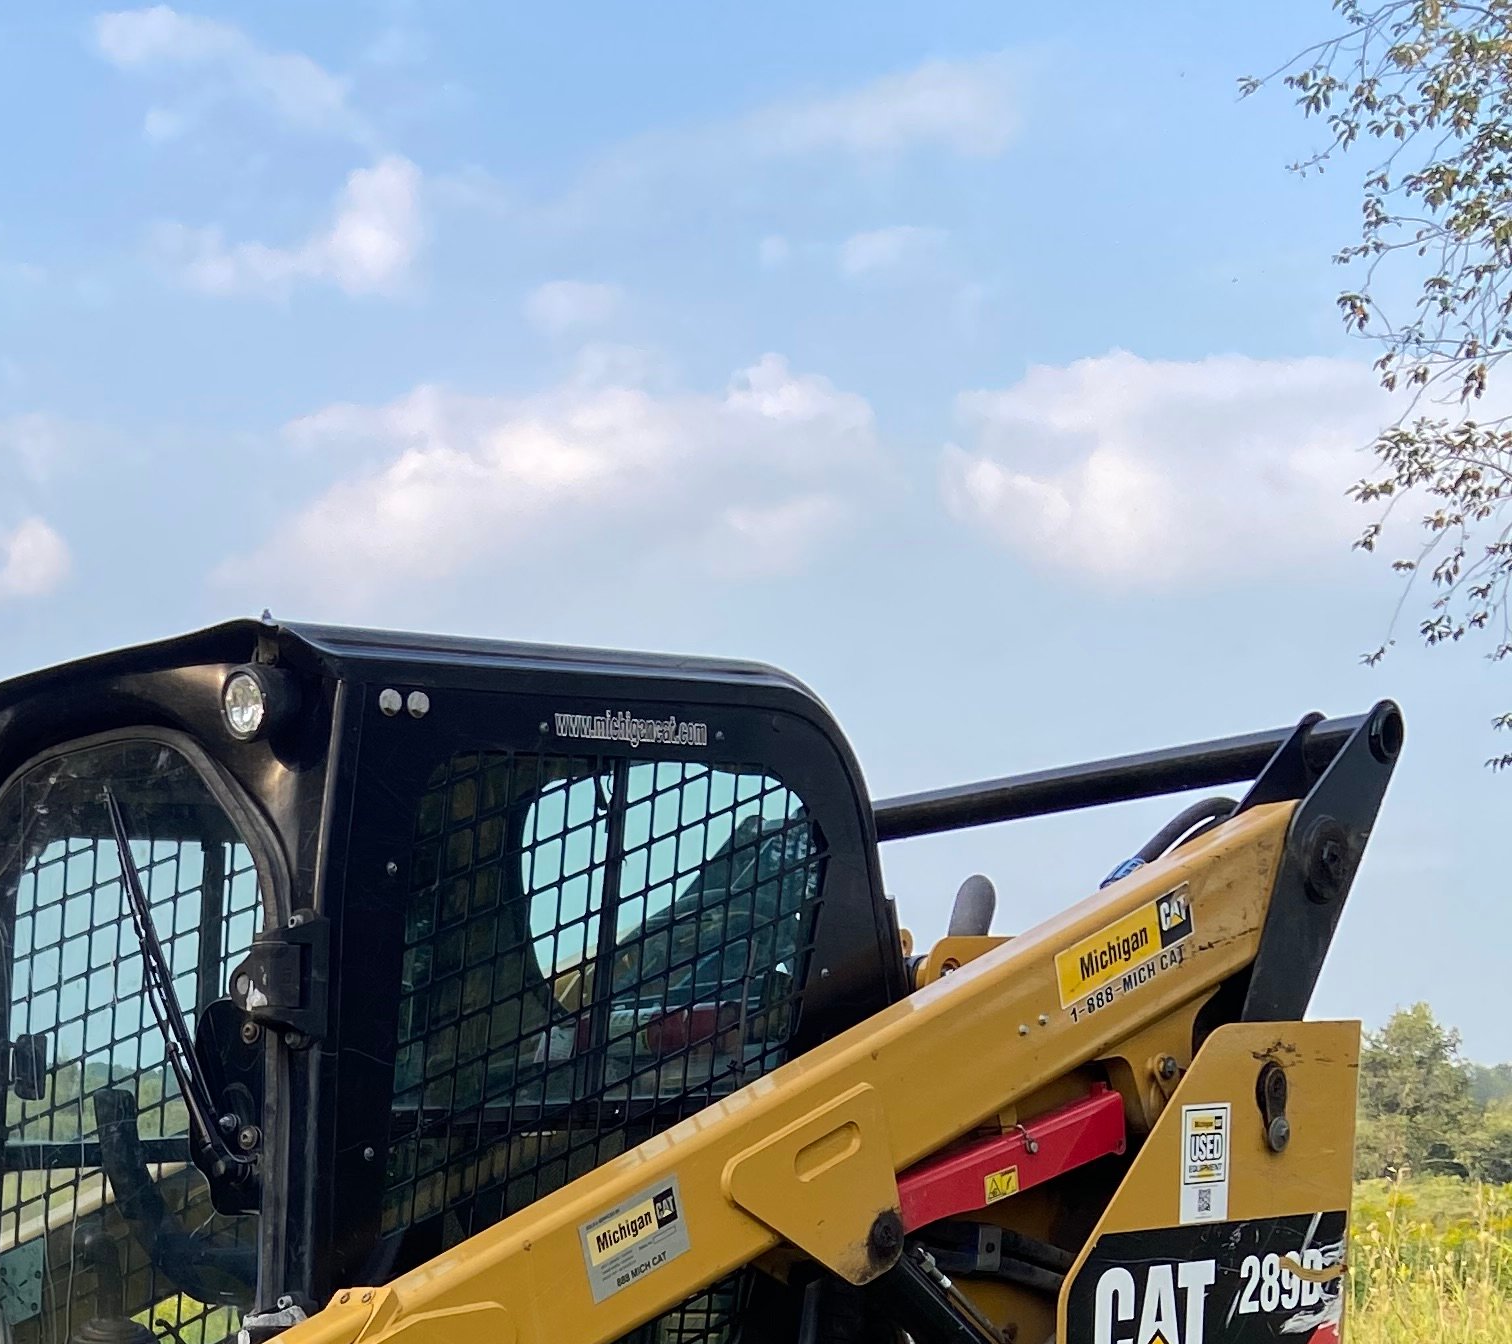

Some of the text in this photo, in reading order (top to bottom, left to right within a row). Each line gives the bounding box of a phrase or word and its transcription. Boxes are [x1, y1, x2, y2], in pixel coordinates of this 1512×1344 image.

[554, 709, 707, 747] www.michigancat.com
[1079, 894, 1188, 981] Michigan CAT
[1069, 944, 1186, 1023] 1-888-MICH CAT
[1190, 1133, 1223, 1162] USED
[595, 1195, 676, 1253] Michigan CAT
[630, 1261, 652, 1279] MICH
[651, 1250, 667, 1266] CAT
[1239, 1248, 1323, 1315] 289D
